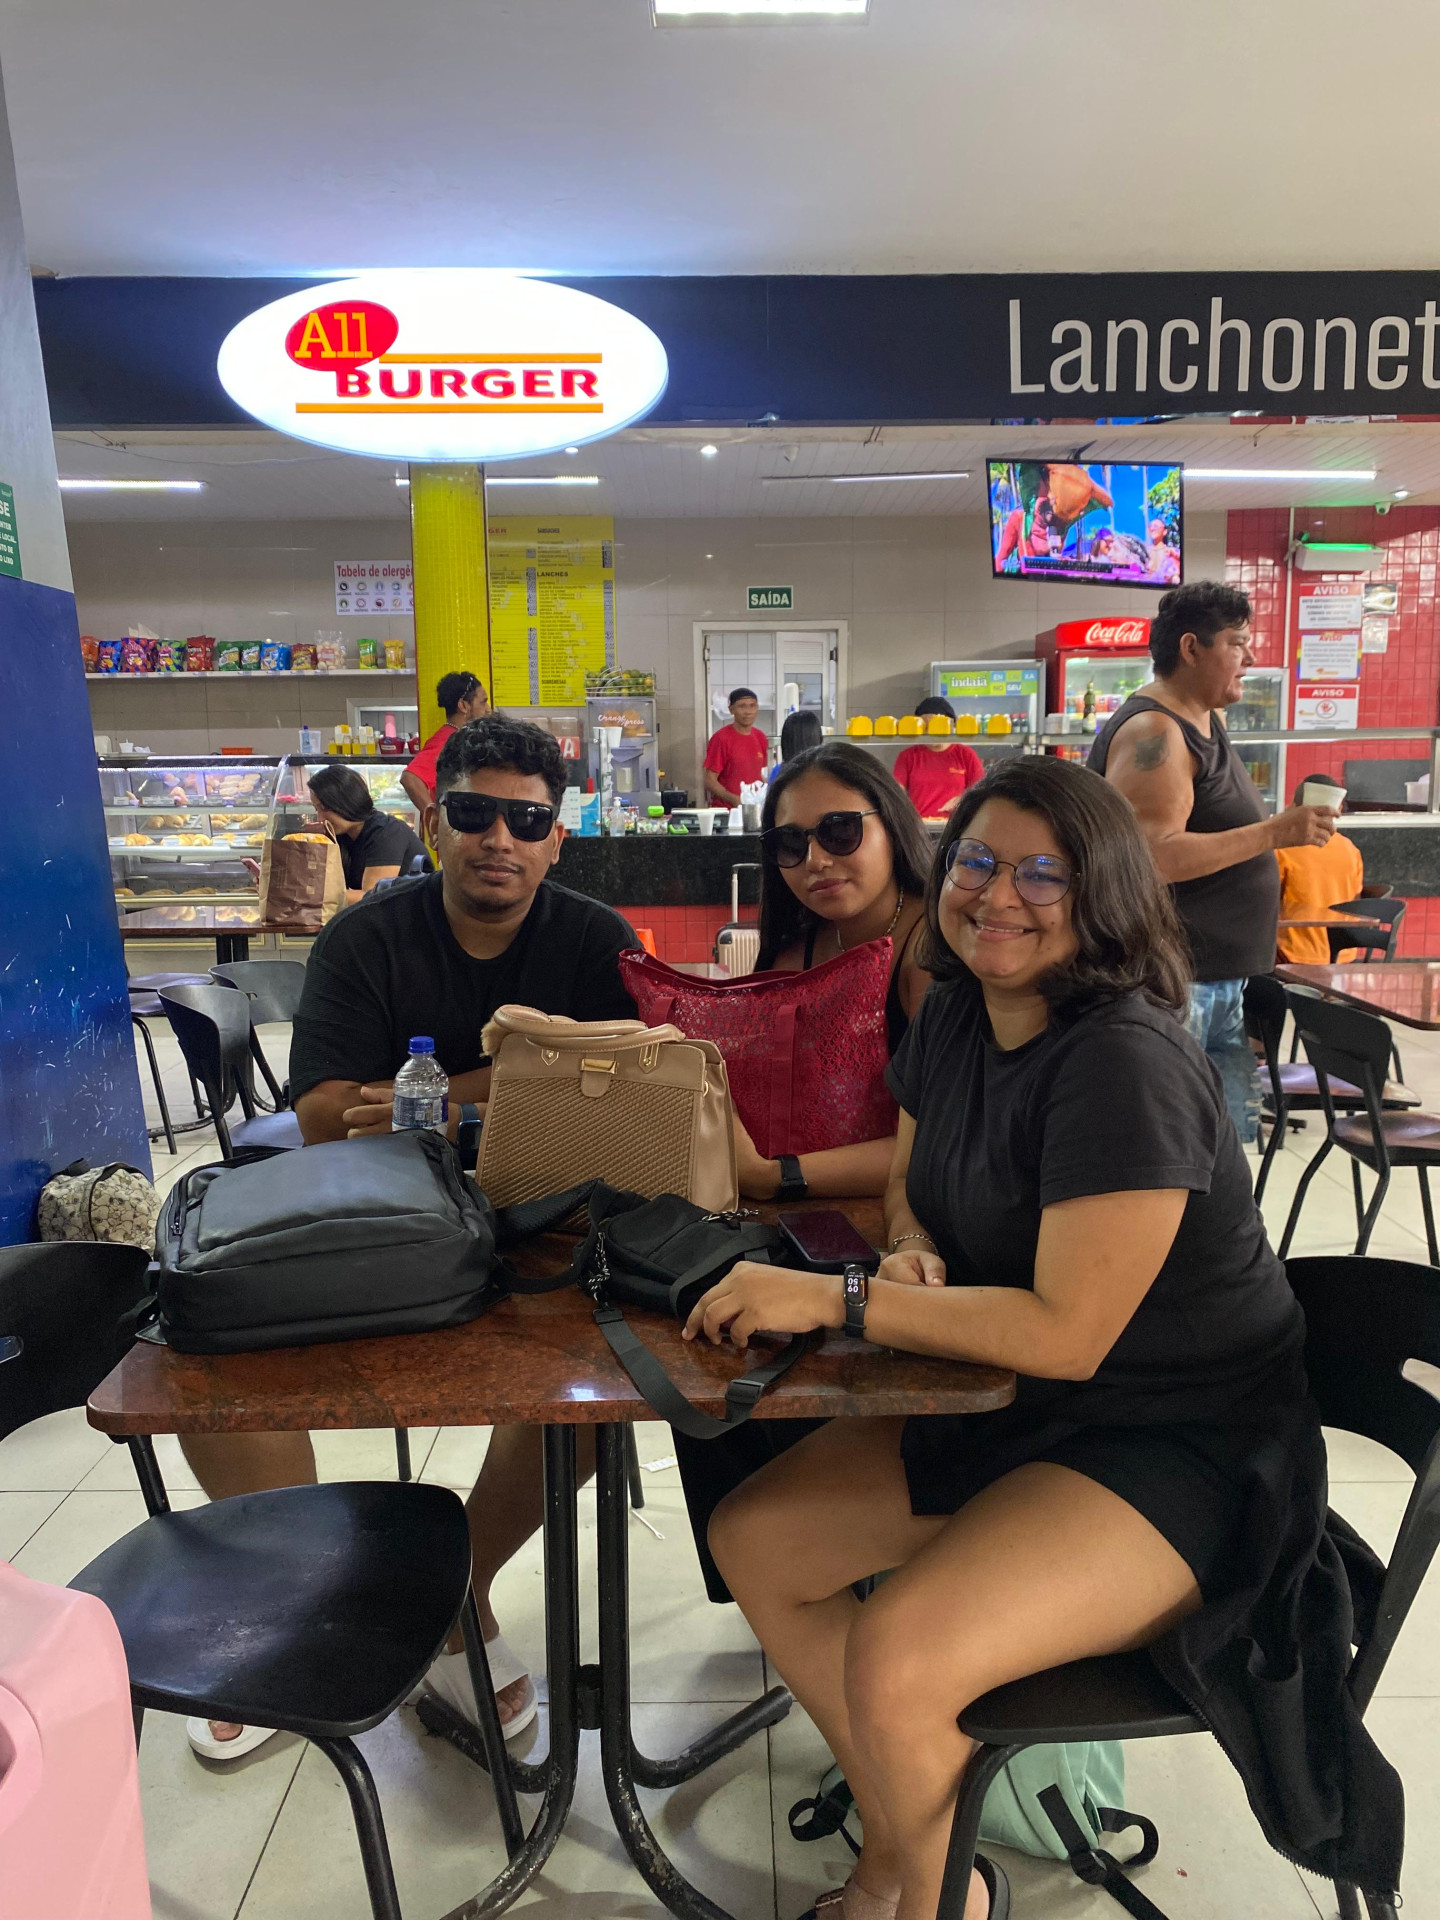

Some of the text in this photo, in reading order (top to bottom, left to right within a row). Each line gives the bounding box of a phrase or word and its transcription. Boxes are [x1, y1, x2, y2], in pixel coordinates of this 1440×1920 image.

[293, 311, 374, 359] All
[336, 367, 600, 399] BURGER
[336, 564, 366, 577] Tabela
[369, 564, 380, 577] de
[750, 590, 790, 606] SAÍDA
[1313, 586, 1349, 596] AVISO
[1312, 689, 1344, 697] AVISO
